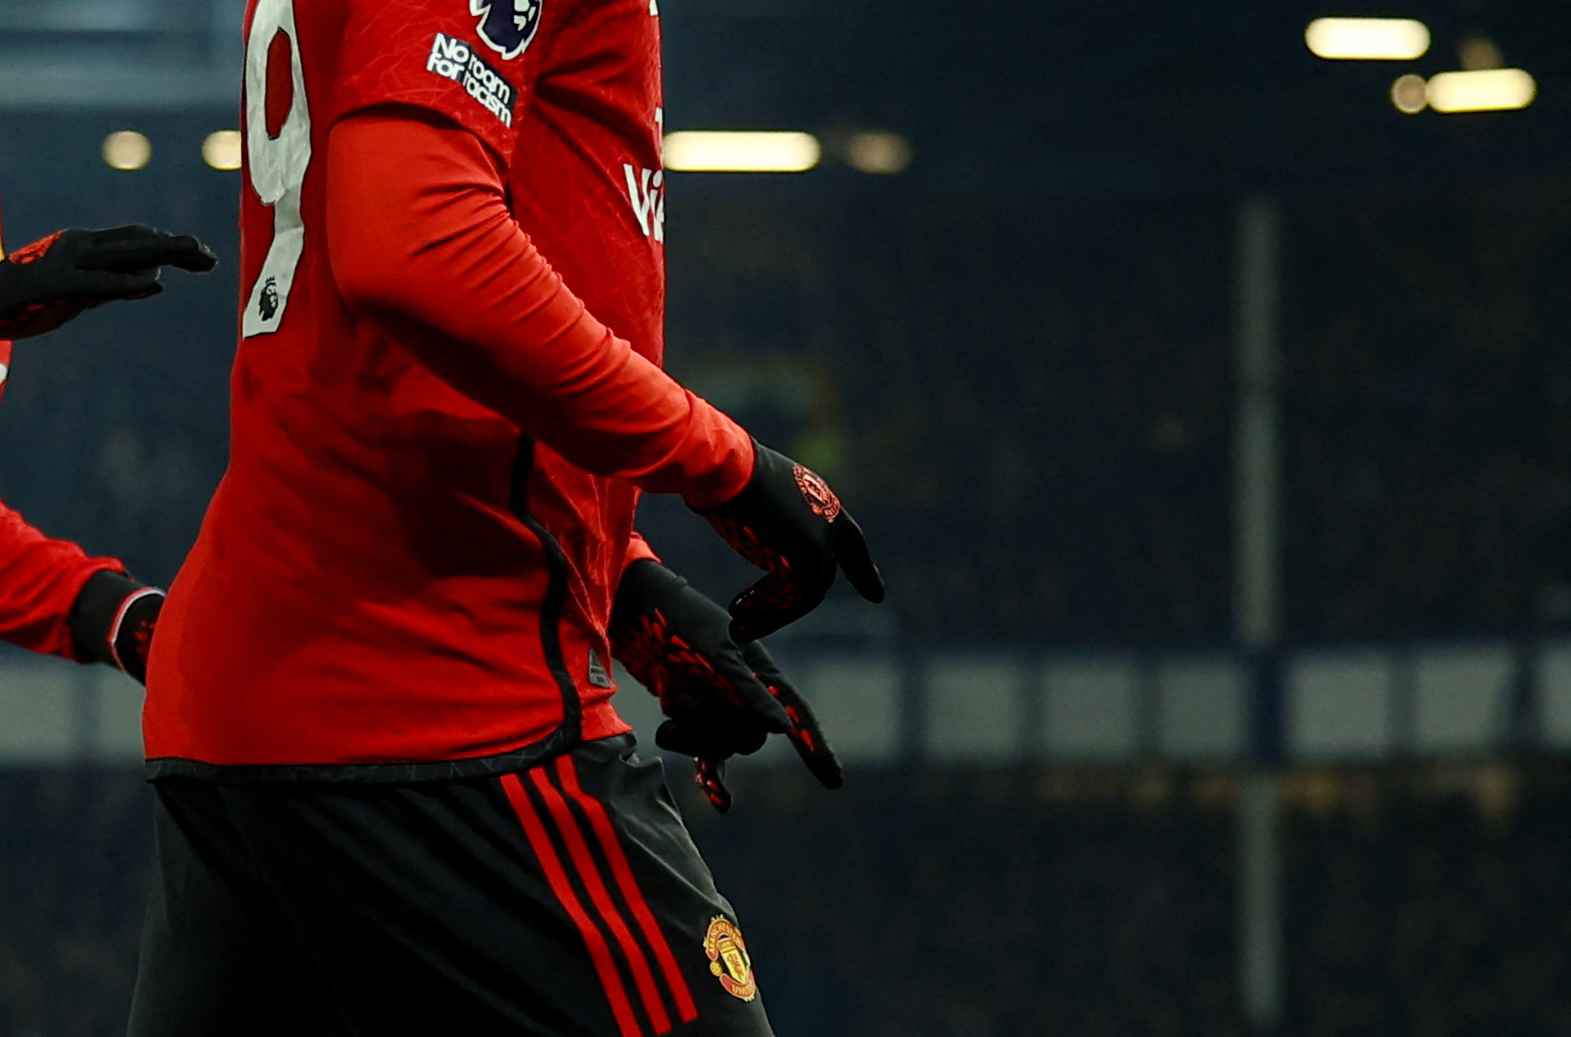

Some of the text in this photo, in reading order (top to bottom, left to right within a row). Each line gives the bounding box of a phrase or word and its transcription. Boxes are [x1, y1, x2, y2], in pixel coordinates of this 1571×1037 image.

[427, 52, 512, 128] for racism
[432, 32, 510, 104] No room
